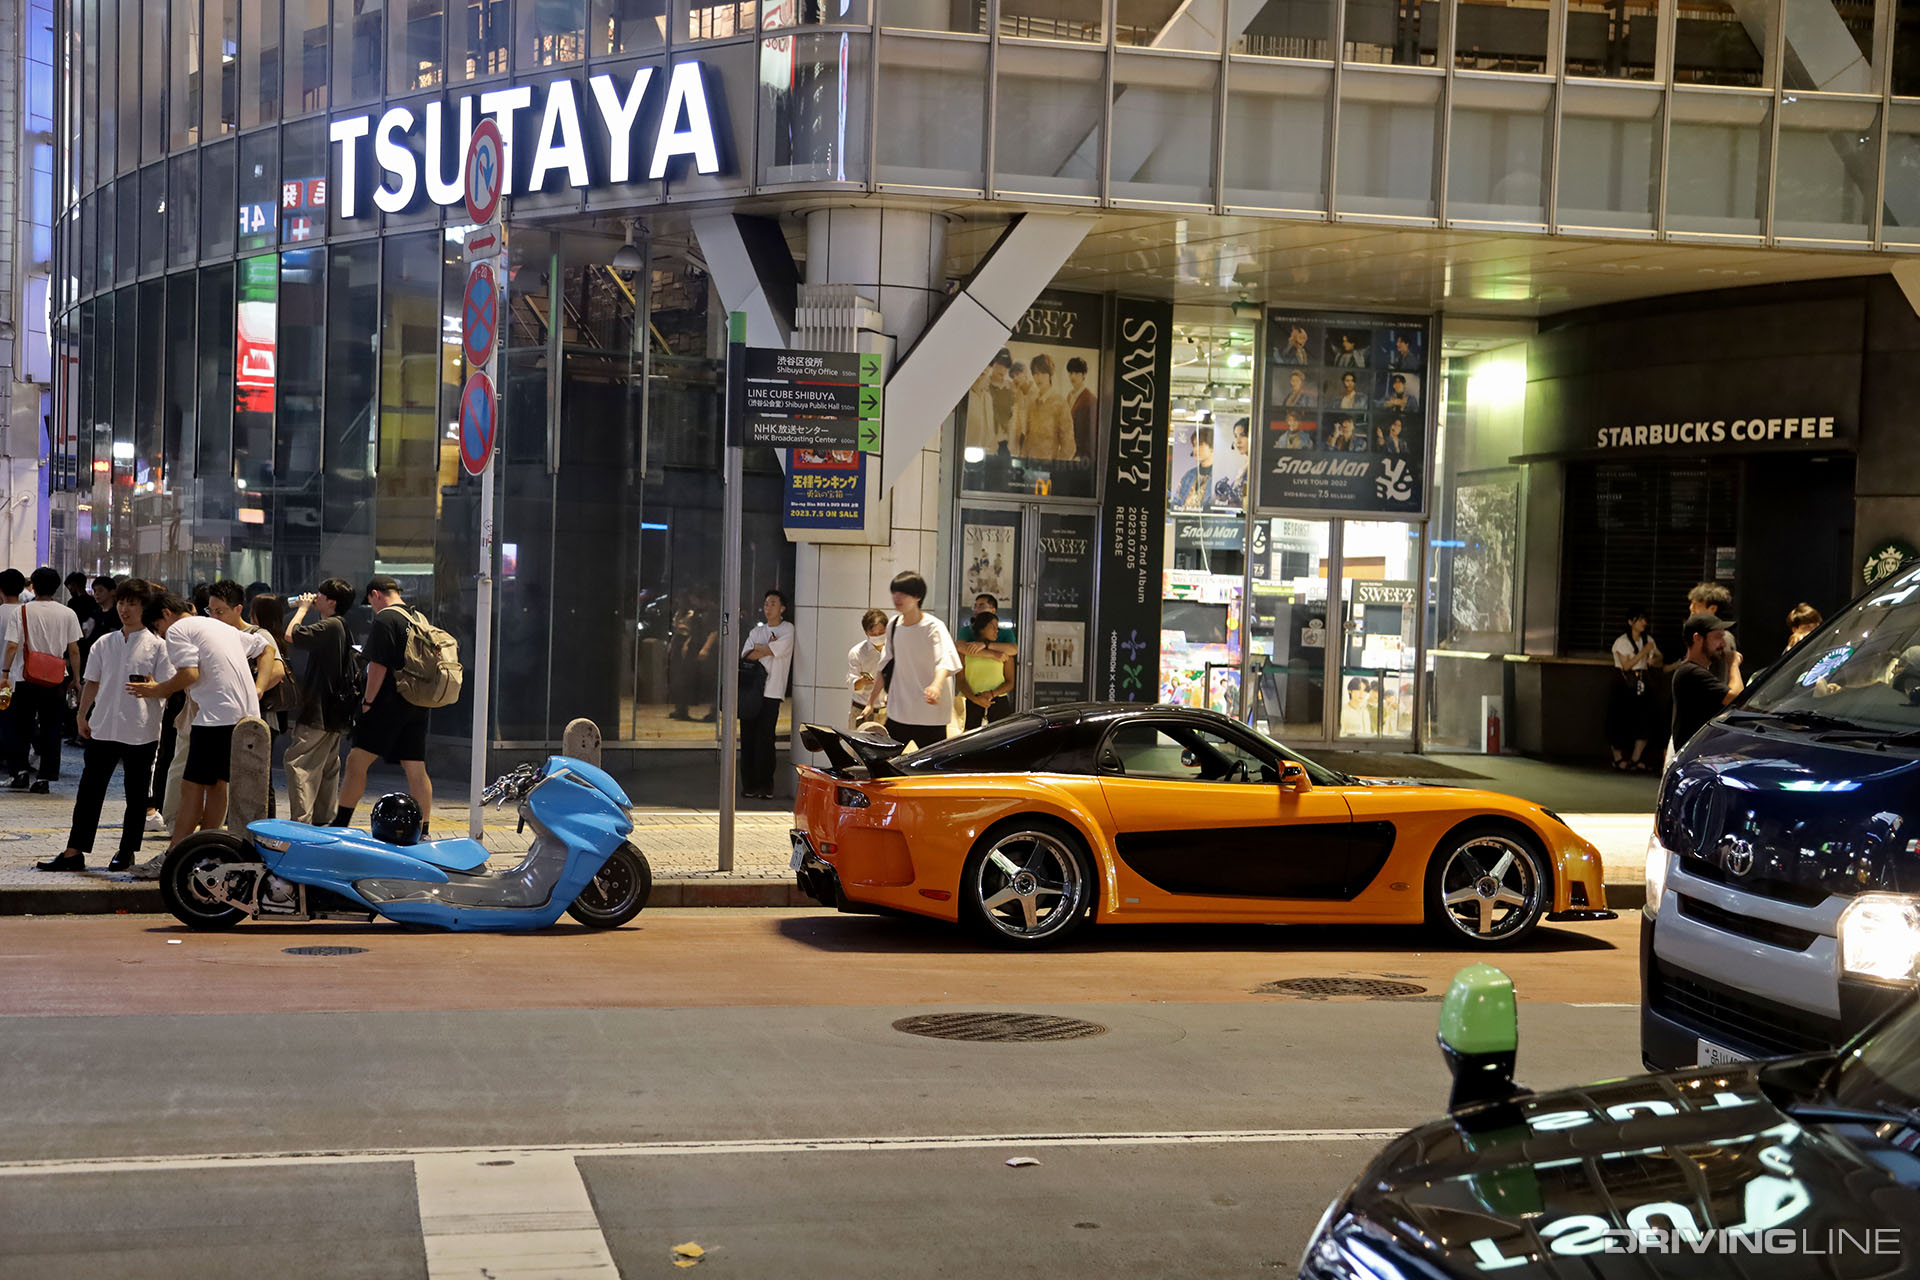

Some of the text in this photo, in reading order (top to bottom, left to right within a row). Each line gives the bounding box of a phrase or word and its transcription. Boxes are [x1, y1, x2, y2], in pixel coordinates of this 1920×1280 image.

[329, 60, 721, 219] TSUTAYA
[777, 355, 824, 368] 渋谷区役所
[776, 366, 803, 376] Shibuya
[803, 367, 819, 377] City
[819, 368, 839, 376] Office
[747, 389, 836, 401] LINE CUBE SHIBUYA
[784, 401, 808, 410] Shibuya
[809, 401, 827, 410] Public
[828, 402, 840, 410] Hall
[1117, 316, 1159, 492] SWEET
[770, 435, 814, 444] Broadcasting
[814, 436, 837, 444] Center
[1596, 416, 1836, 449] STARBUCKS COFFEE
[1272, 456, 1370, 477] Snow Man
[792, 474, 859, 489] 王様ランキング
[1318, 489, 1329, 498] 7.5
[790, 509, 859, 518] 2023.7.5 ON SALE
[966, 526, 1013, 544] SWEET
[1114, 506, 1125, 557] RELEASE
[1126, 506, 1138, 570] 2023.07.05
[1180, 525, 1239, 539] Snow Man
[1039, 536, 1088, 556] SWEET
[1136, 507, 1150, 604] Japan 2nd Album
[1359, 586, 1416, 603] SWEET
